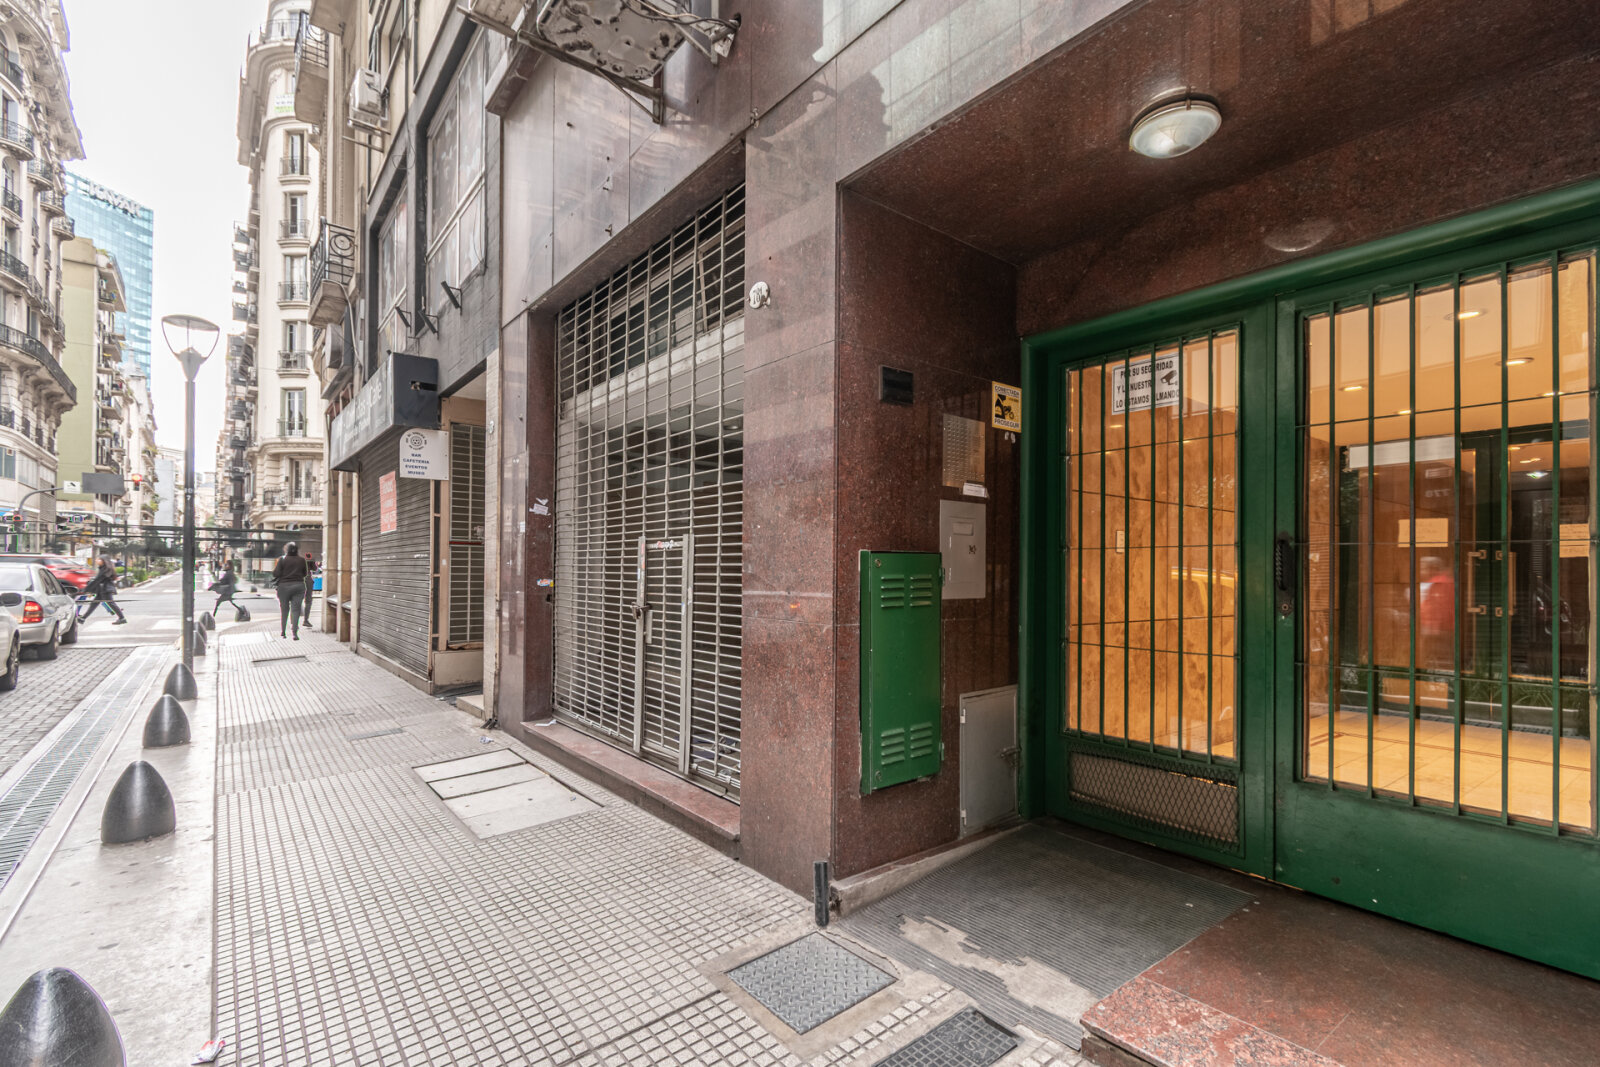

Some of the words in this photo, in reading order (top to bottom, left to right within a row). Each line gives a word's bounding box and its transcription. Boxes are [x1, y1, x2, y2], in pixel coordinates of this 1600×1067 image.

[1132, 367, 1140, 377] SU
[1140, 360, 1174, 375] SEGRIDAD
[1116, 385, 1121, 394] Y
[1130, 379, 1154, 391] NUESTR
[1116, 399, 1123, 408] LO
[994, 418, 1020, 428] PROSEGUR
